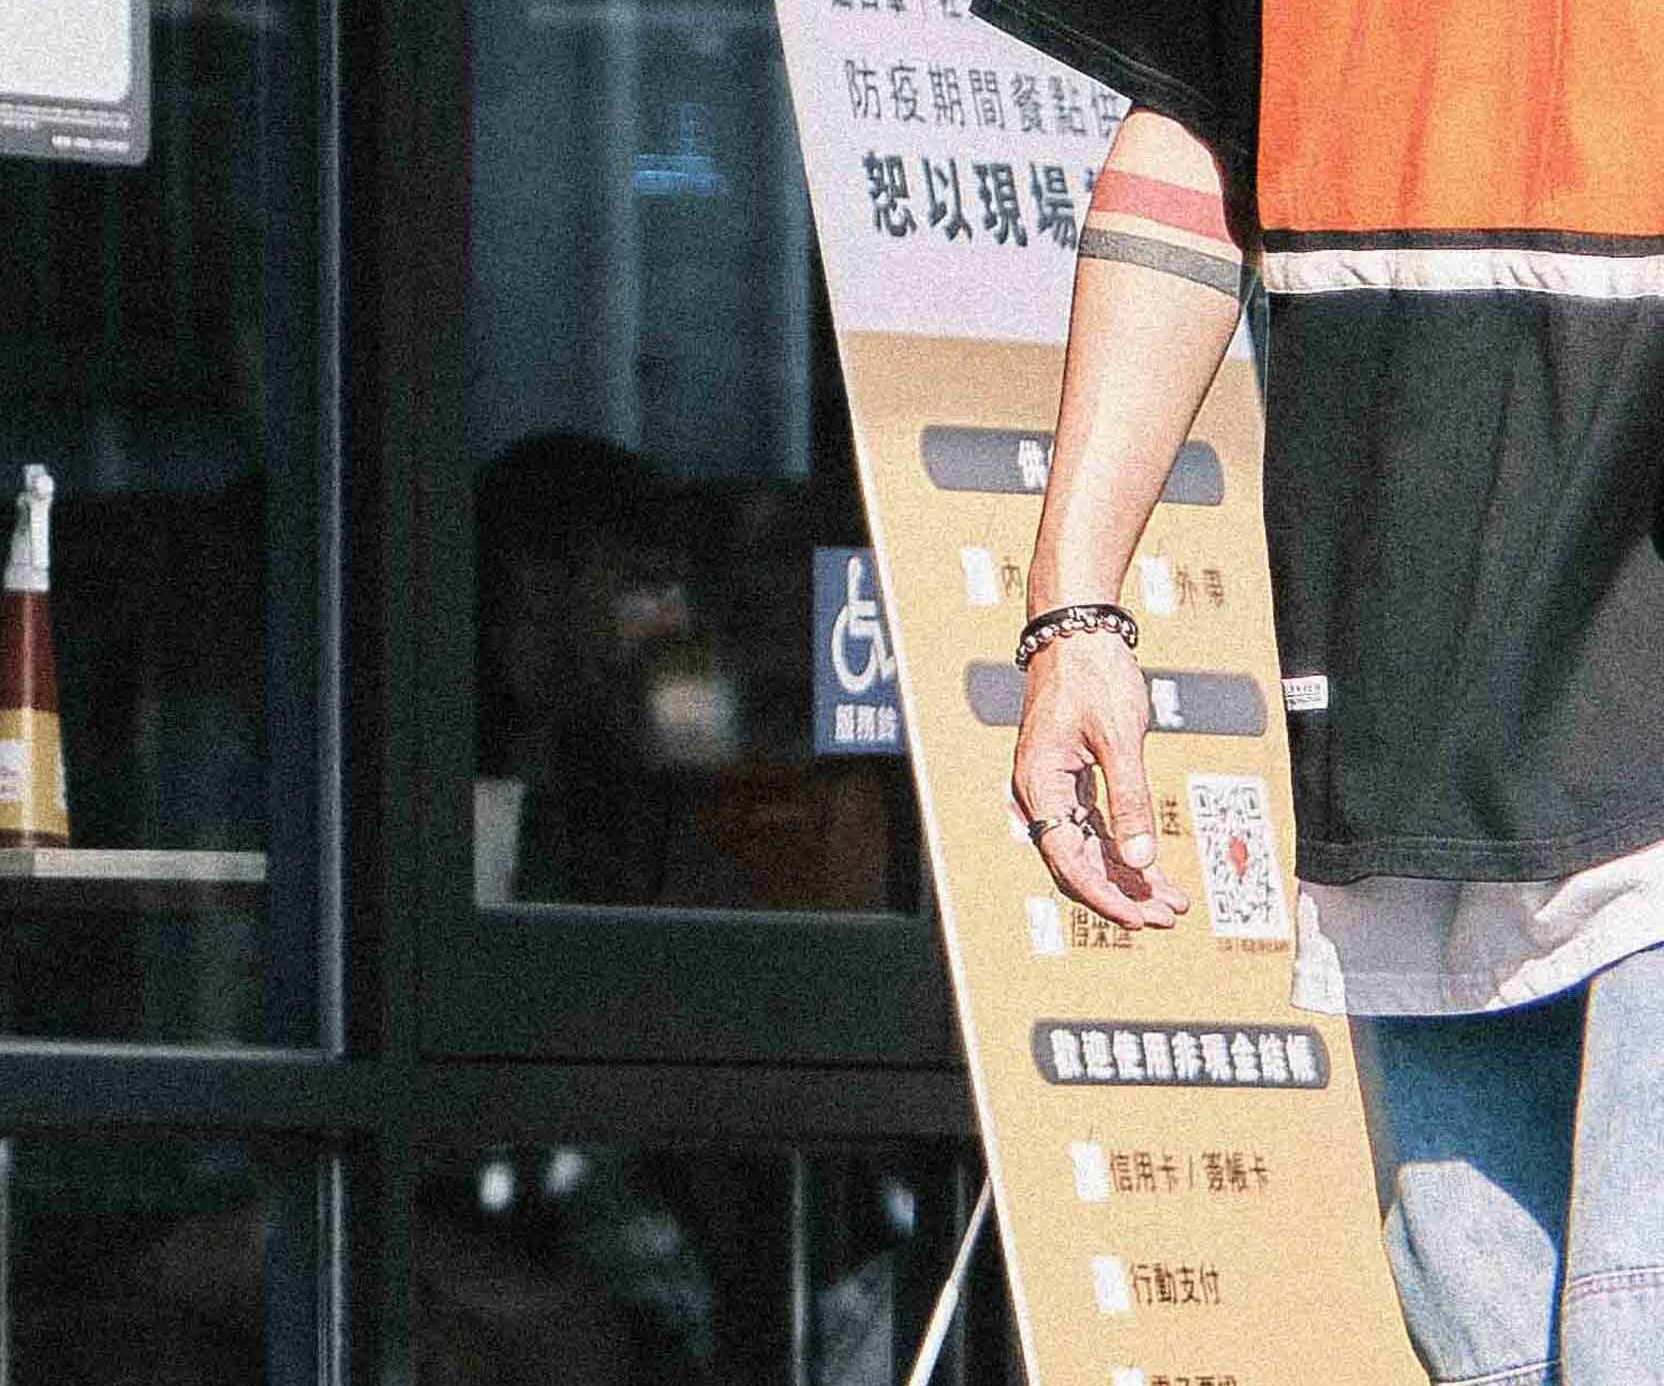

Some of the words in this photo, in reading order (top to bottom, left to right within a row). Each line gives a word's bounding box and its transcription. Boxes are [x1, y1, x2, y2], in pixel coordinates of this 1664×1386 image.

[862, 151, 1096, 250] 恕以現場
[1130, 1262, 1221, 1307] 行動支付
